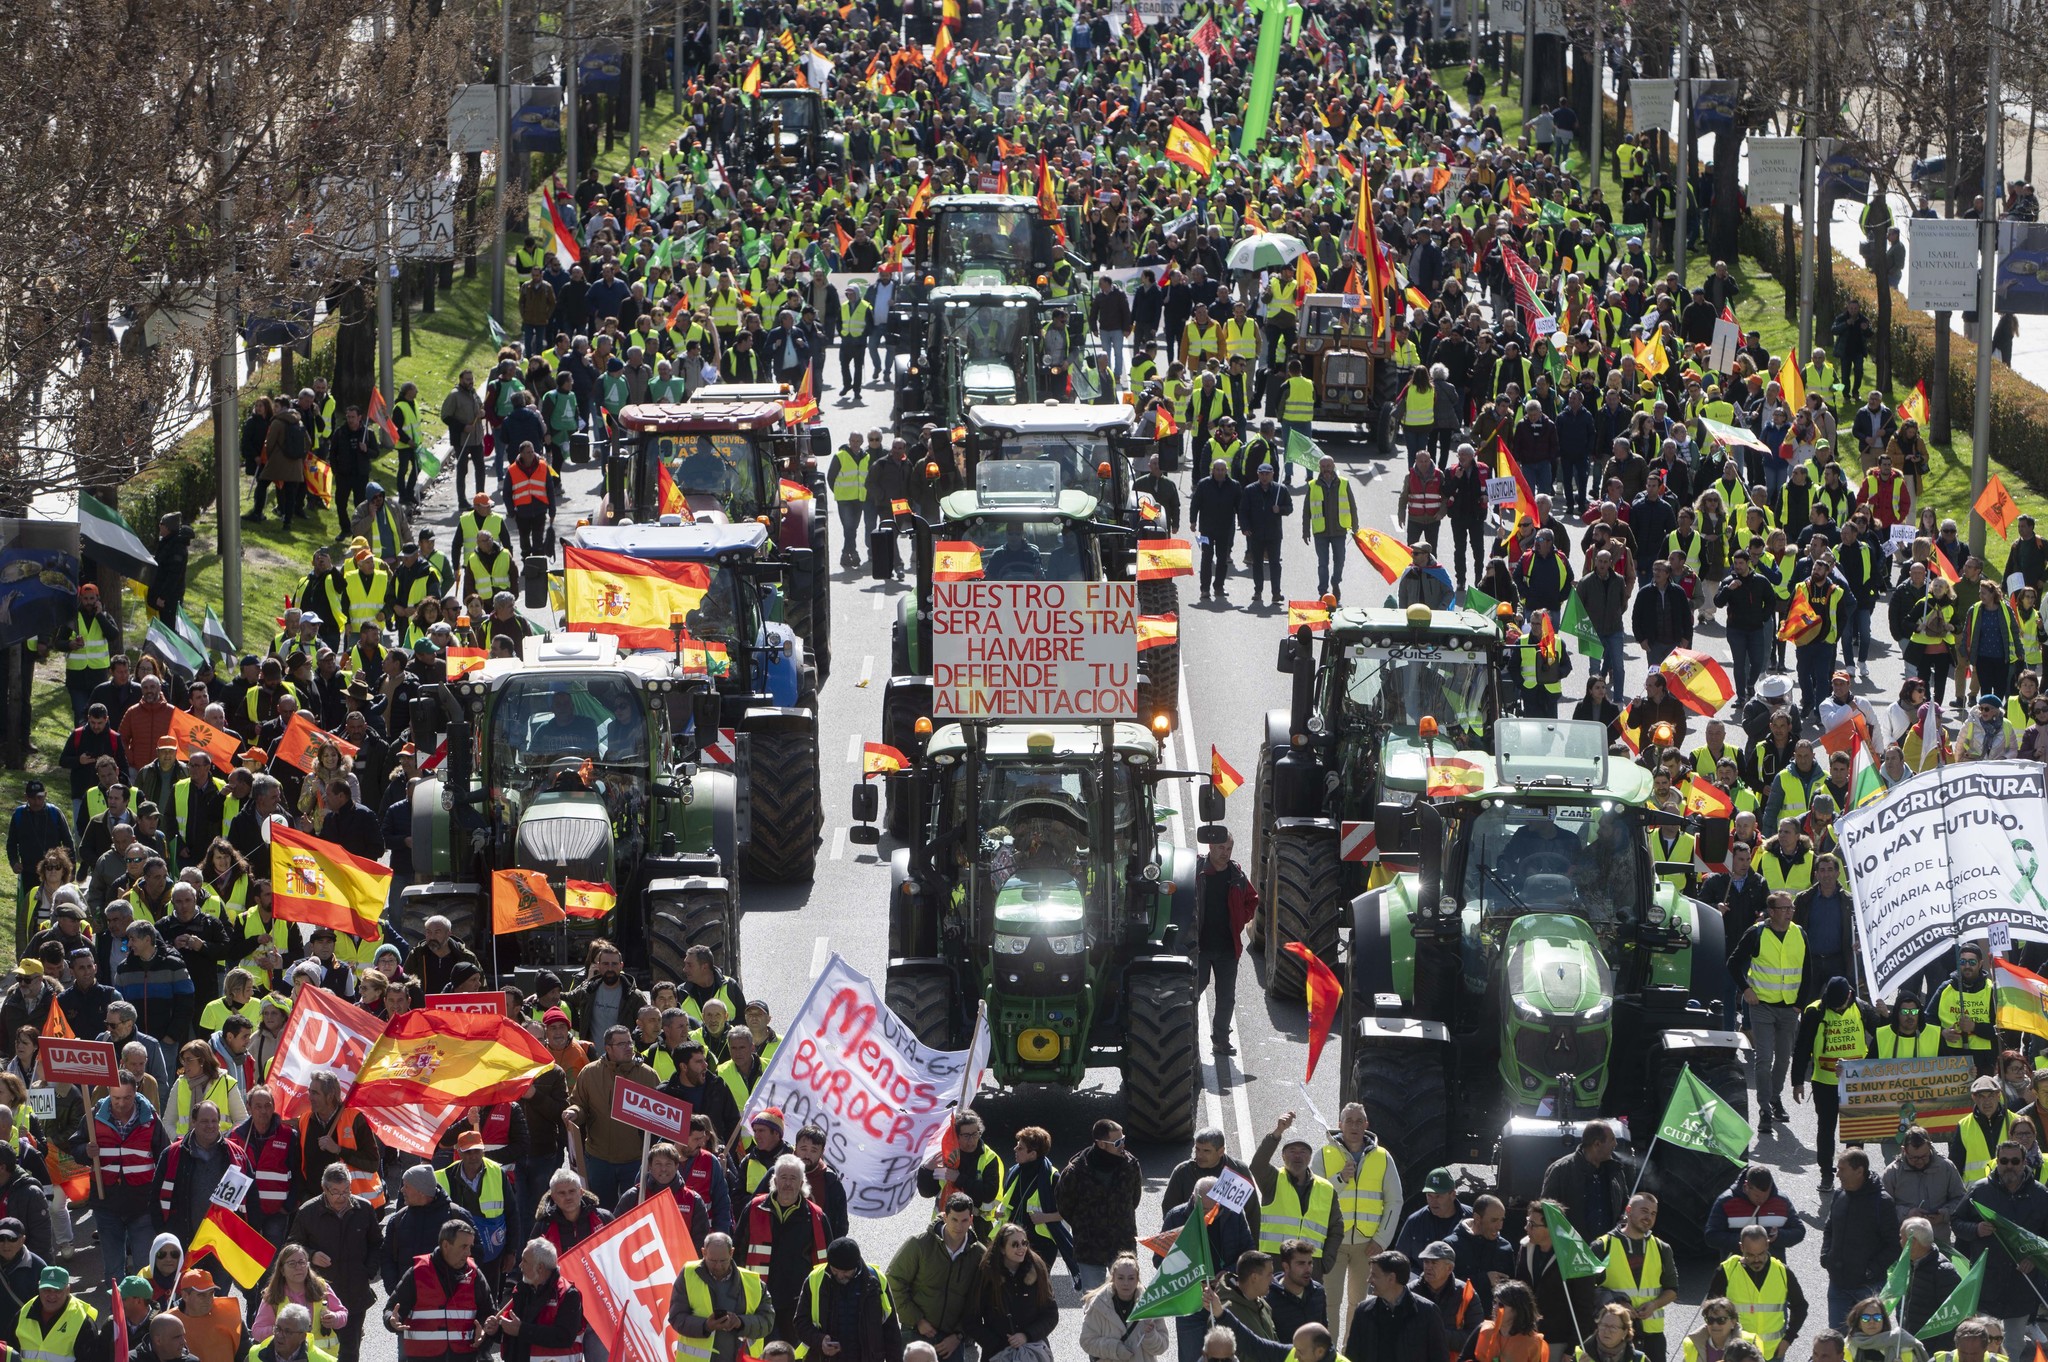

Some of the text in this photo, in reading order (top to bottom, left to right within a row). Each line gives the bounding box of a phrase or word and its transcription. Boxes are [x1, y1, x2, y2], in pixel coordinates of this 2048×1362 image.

[1911, 260, 1975, 270] QUINTANILLA
[1928, 250, 1959, 259] ISABEL
[933, 583, 1135, 609] NUESTRO FIN
[933, 610, 1137, 635] SERA VUESTRA
[967, 637, 1085, 662] HAMBRE
[1388, 649, 1442, 661] QUILES
[934, 662, 1129, 688] DEFIENDE TU
[933, 689, 1137, 715] ALIMENTACION
[1848, 776, 2044, 849] SIN AGRICULTURA,
[1854, 854, 1879, 884] NO
[1883, 826, 1925, 862] HAY
[1870, 866, 1911, 904] SETOR
[1914, 859, 1934, 873] DE
[1938, 856, 1954, 868] LA
[1866, 865, 2001, 936] MAUINARIA AGRÍCOLA
[1918, 909, 1927, 921] A
[1930, 889, 1998, 916] NUESTROS
[1875, 925, 1959, 985] AGRICULTORES
[1966, 912, 2048, 932] GANADERO
[50, 1049, 106, 1066] UAGN
[1824, 1043, 1856, 1053] HAMBRE
[1845, 1056, 1969, 1079] LA AGRICULTURA
[1845, 1072, 1969, 1093] ES MUY FÁCIL CUANDO
[625, 1090, 681, 1124] UAGN
[1848, 1096, 1861, 1105] SE
[1864, 1094, 1887, 1104] ARA
[1889, 1091, 1915, 1101] CON
[1918, 1089, 1934, 1099] UN
[393, 1129, 426, 1153] NAVARRA
[581, 1256, 598, 1285] UNIÓN
[596, 1284, 605, 1296] DE
